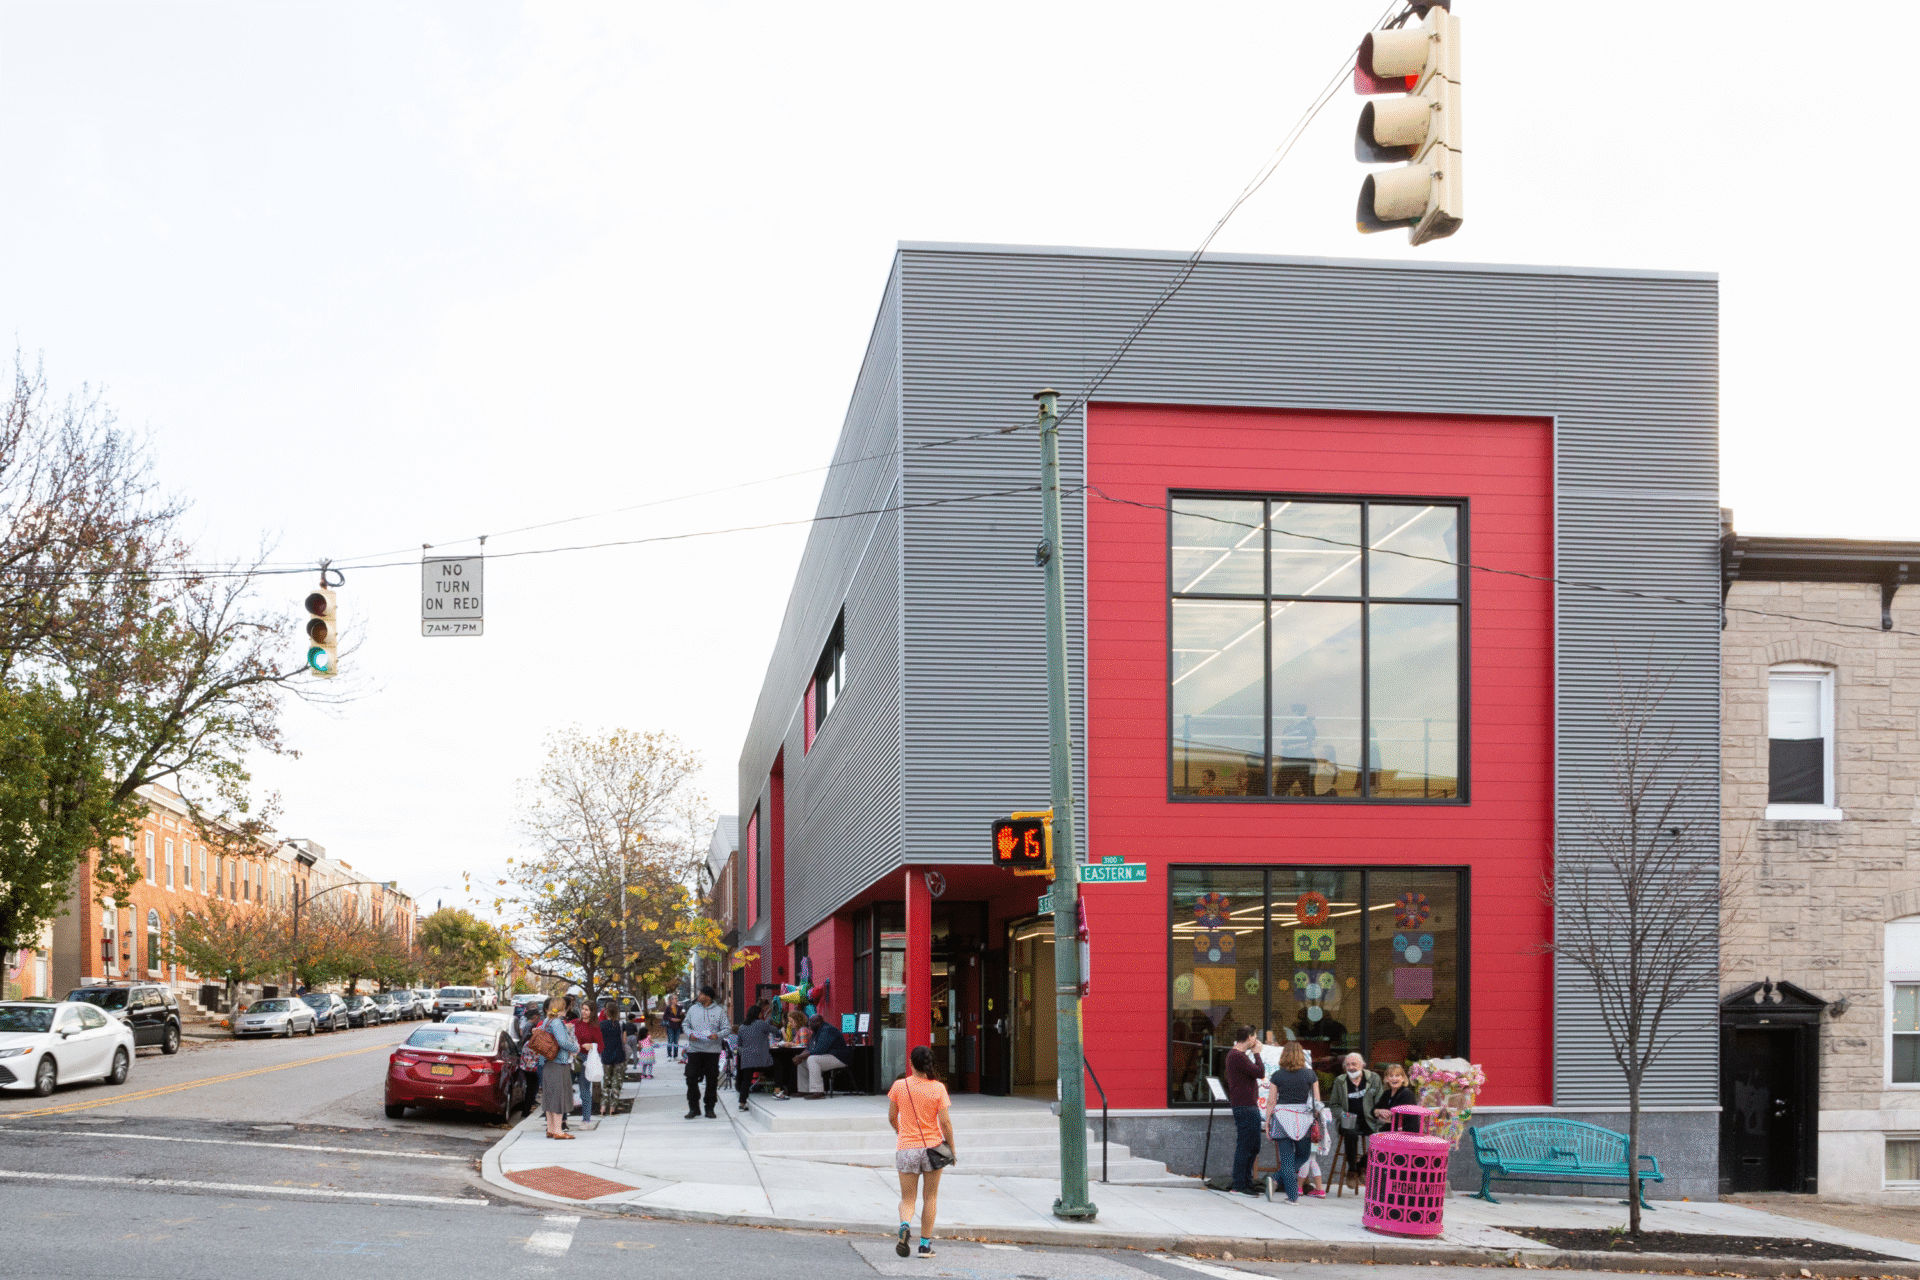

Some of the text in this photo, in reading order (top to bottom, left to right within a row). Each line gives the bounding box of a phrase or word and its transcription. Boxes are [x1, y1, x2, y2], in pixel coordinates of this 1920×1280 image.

[442, 564, 463, 576] NO
[436, 581, 470, 593] TURN
[426, 597, 479, 610] ON RED
[426, 624, 477, 633] 7AM-7PM
[1024, 829, 1040, 858] 15
[1084, 867, 1132, 880] EASTERN
